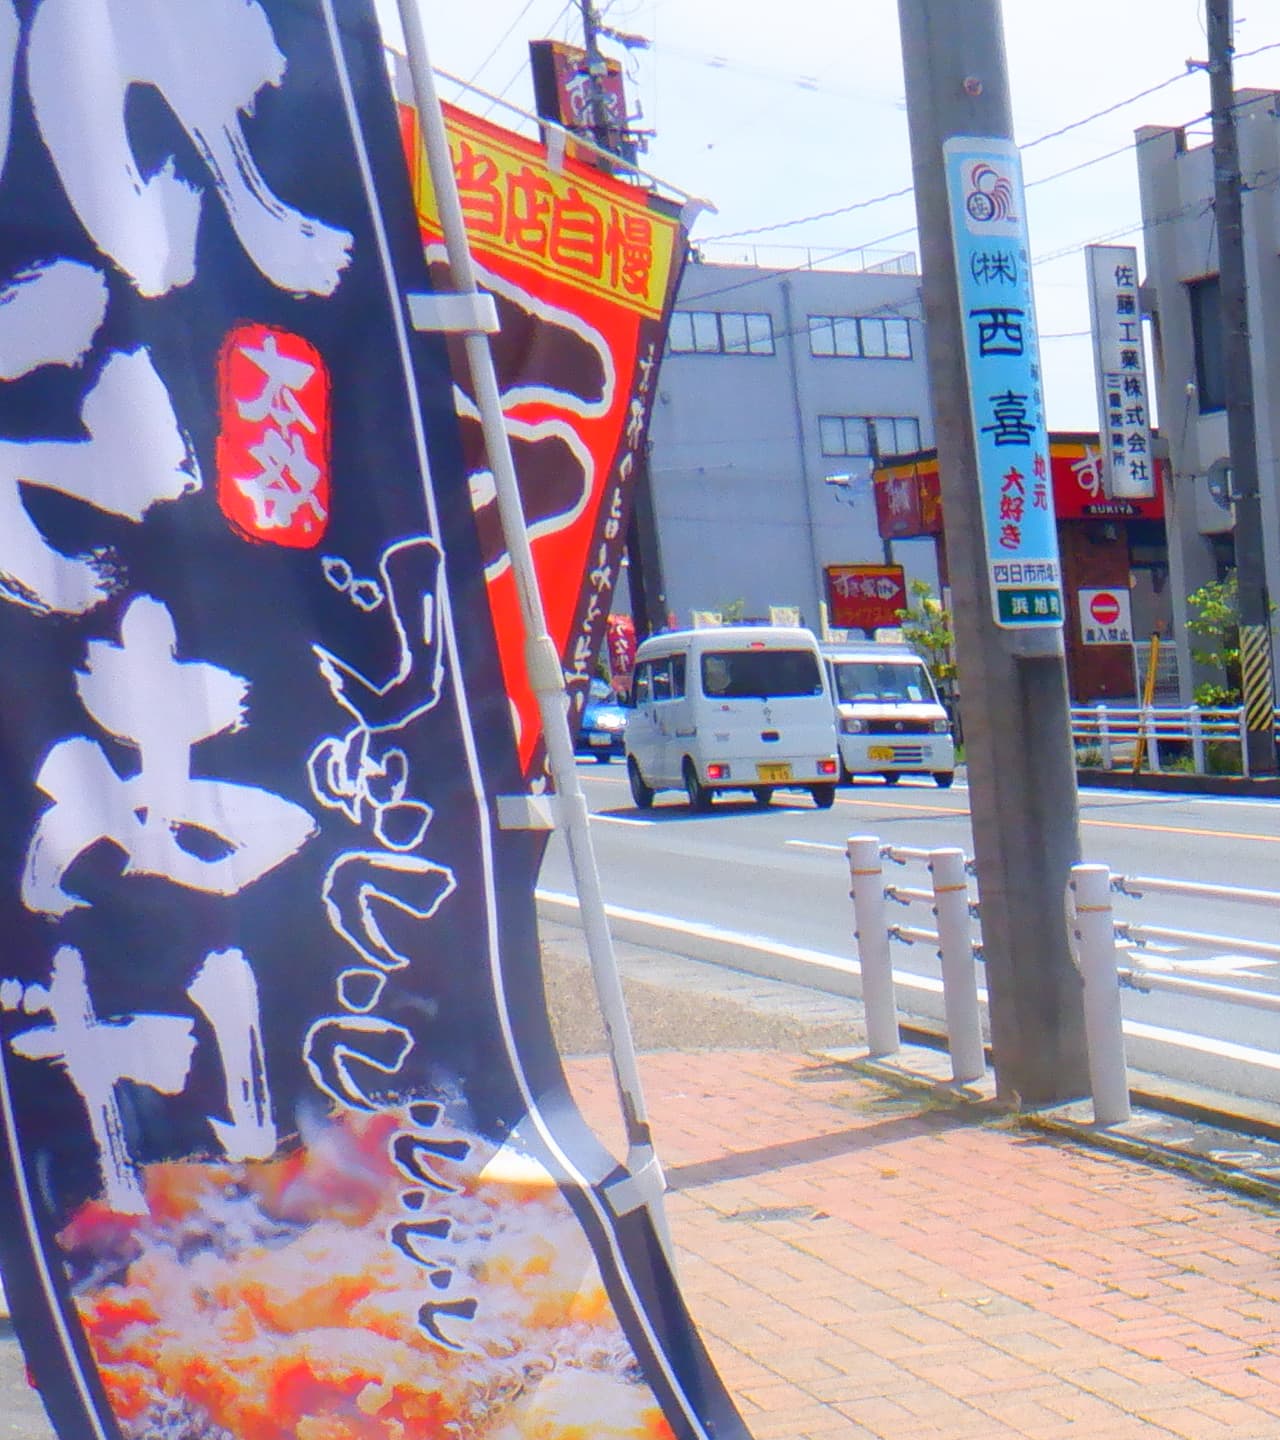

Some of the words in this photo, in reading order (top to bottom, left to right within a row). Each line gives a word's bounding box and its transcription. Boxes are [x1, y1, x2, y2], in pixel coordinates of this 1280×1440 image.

[449, 139, 654, 302] 当店自慢
[1114, 265, 1149, 481] 佐藤工業株式会社
[999, 466, 1025, 550] 大好き
[1032, 451, 1048, 511] 地元
[1089, 505, 1134, 515] SUKIYA
